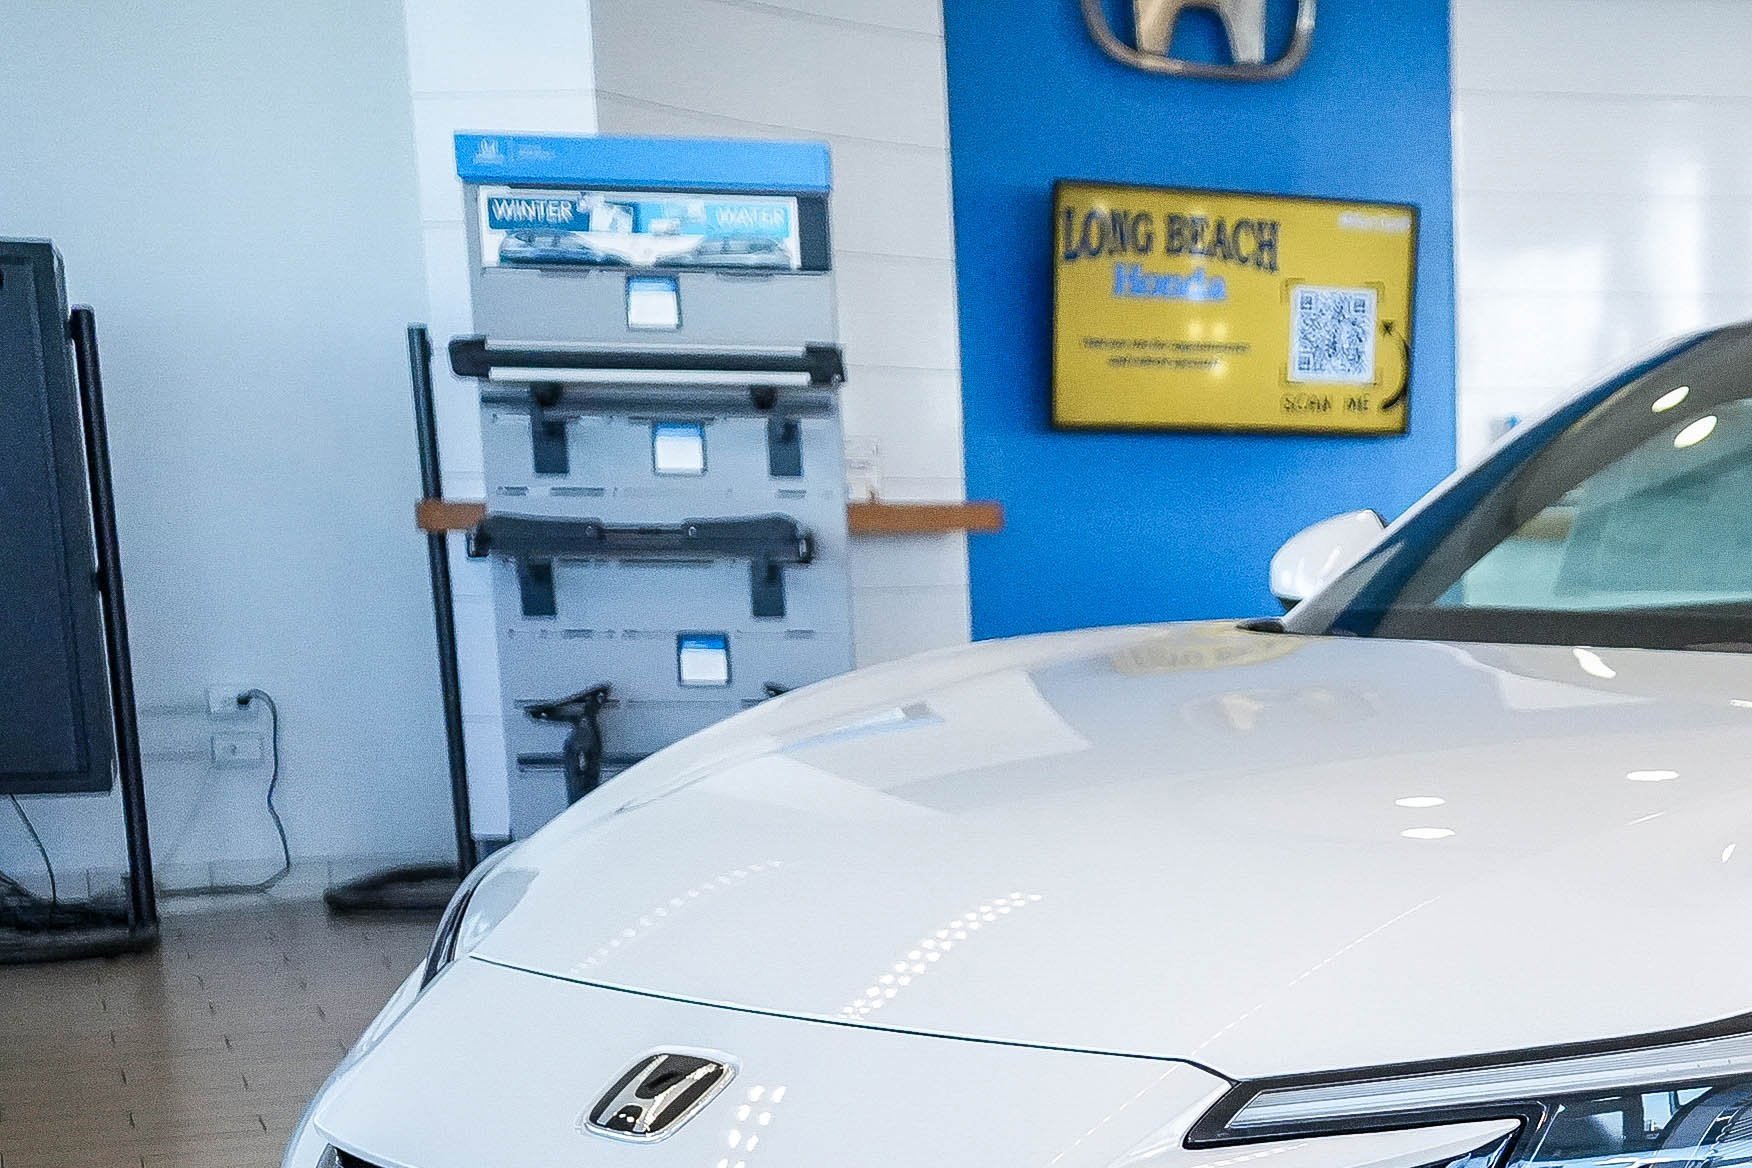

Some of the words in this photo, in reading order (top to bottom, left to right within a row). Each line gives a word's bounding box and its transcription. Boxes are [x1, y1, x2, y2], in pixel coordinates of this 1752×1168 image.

[491, 198, 575, 222] WINTER
[1063, 206, 1152, 261] LONG
[1167, 213, 1279, 273] BEACH
